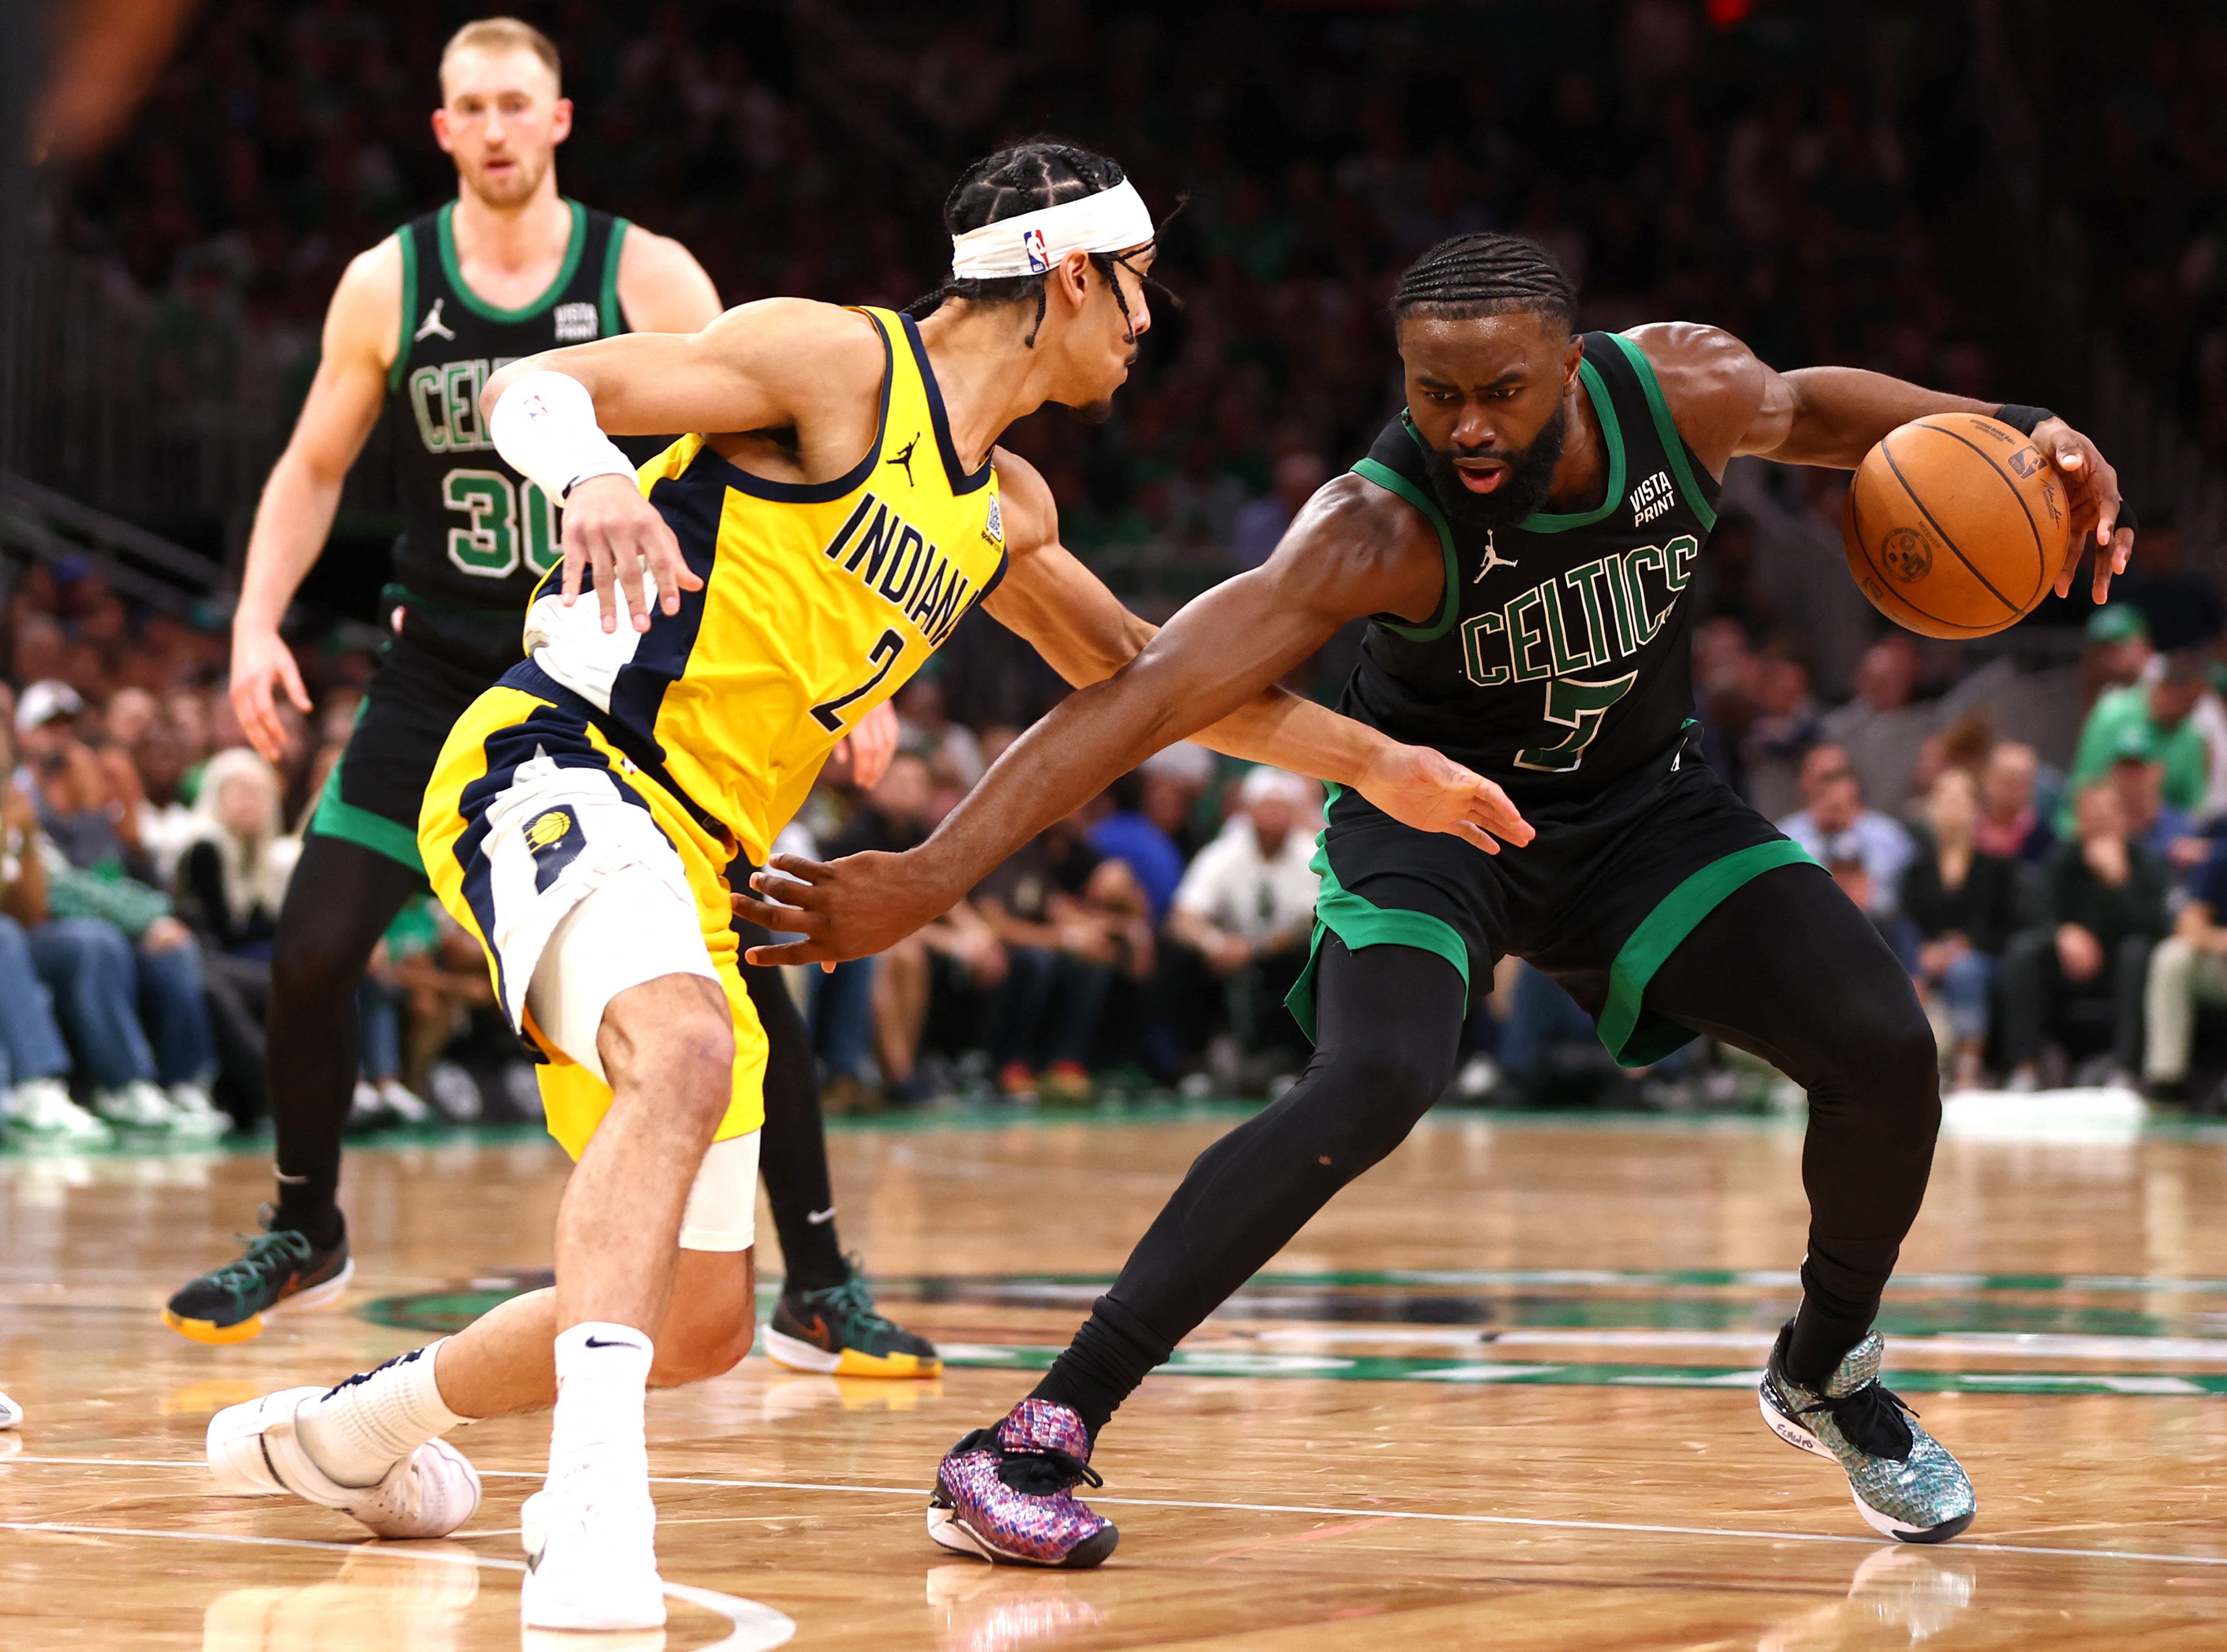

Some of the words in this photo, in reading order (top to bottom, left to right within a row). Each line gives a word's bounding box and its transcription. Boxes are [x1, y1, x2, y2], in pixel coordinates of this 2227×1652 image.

[1630, 471, 1672, 513] VISTA
[1635, 490, 1675, 528] PRINT
[809, 626, 906, 733] 2
[1514, 670, 1638, 772] 7
